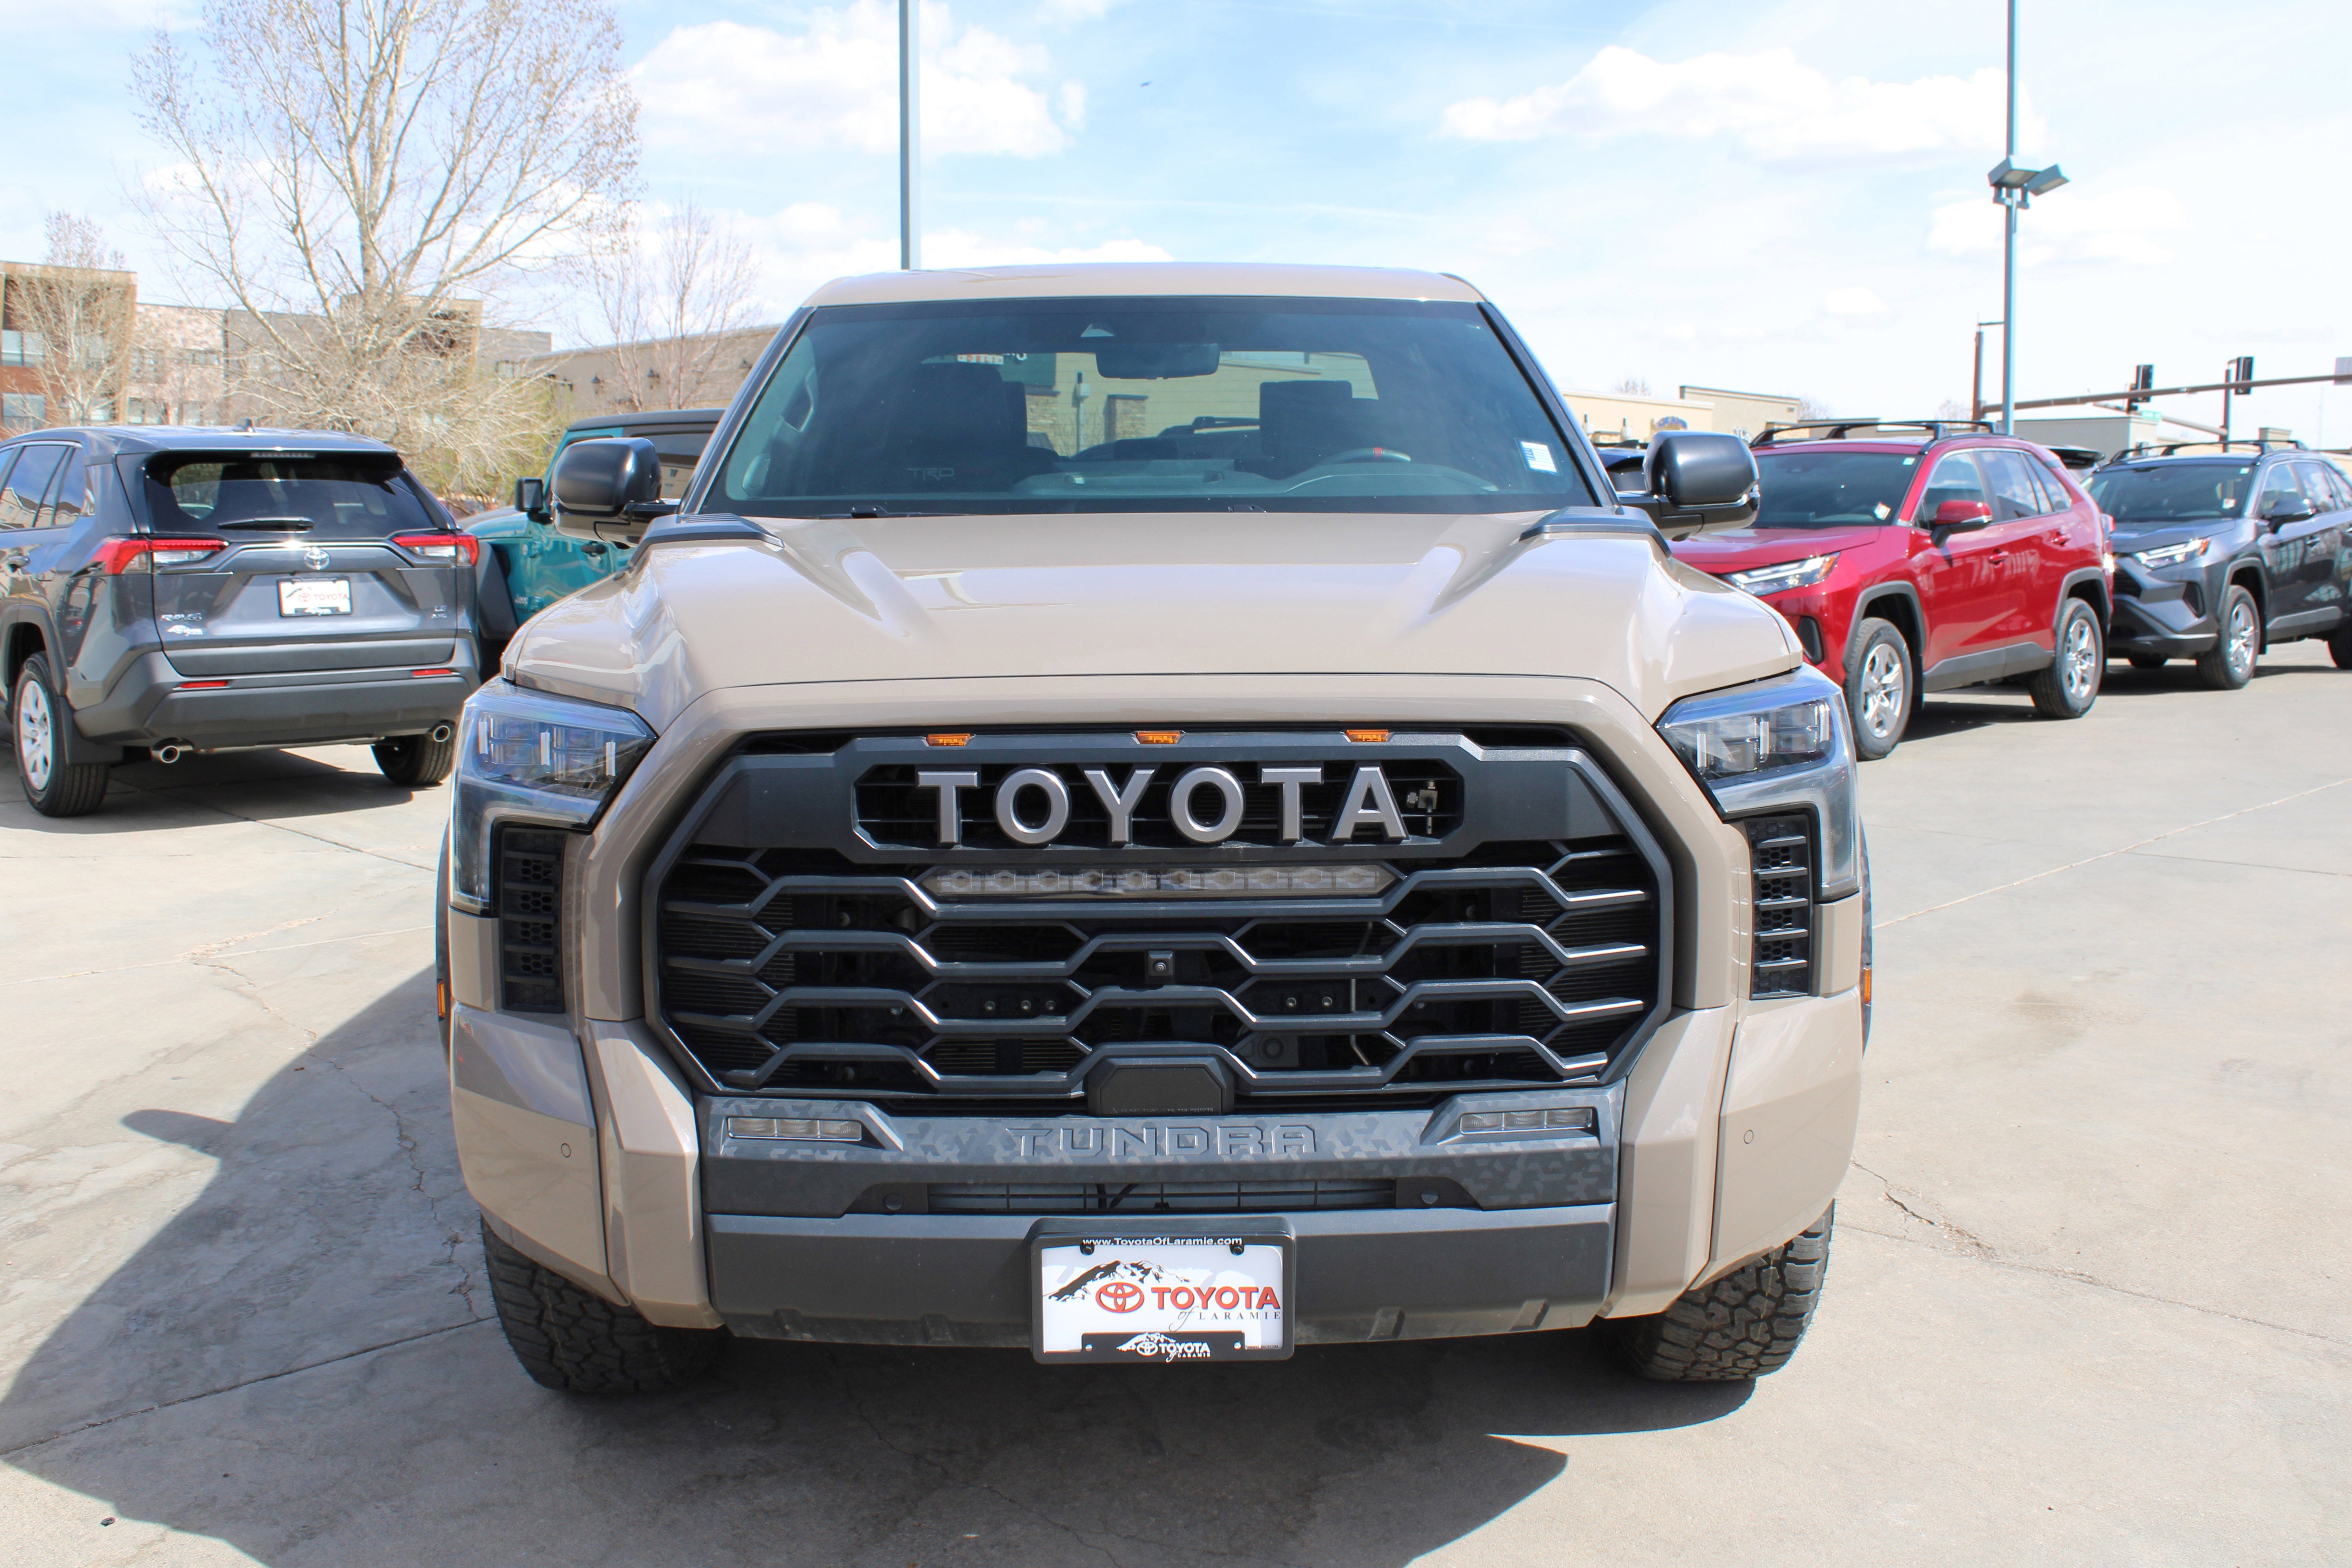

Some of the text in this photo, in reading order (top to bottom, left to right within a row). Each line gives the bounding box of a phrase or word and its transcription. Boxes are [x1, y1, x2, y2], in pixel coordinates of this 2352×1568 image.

[907, 468, 955, 480] TRD
[917, 765, 1410, 844] TOYOTA
[1005, 1124, 1316, 1156] TUNDRA
[1082, 1236, 1242, 1246] www.ToyotaOfLaramie.com
[1151, 1286, 1281, 1310] TOYOTA
[1168, 1305, 1281, 1332] of LARAMIE
[1159, 1342, 1211, 1354] TOYOTA
